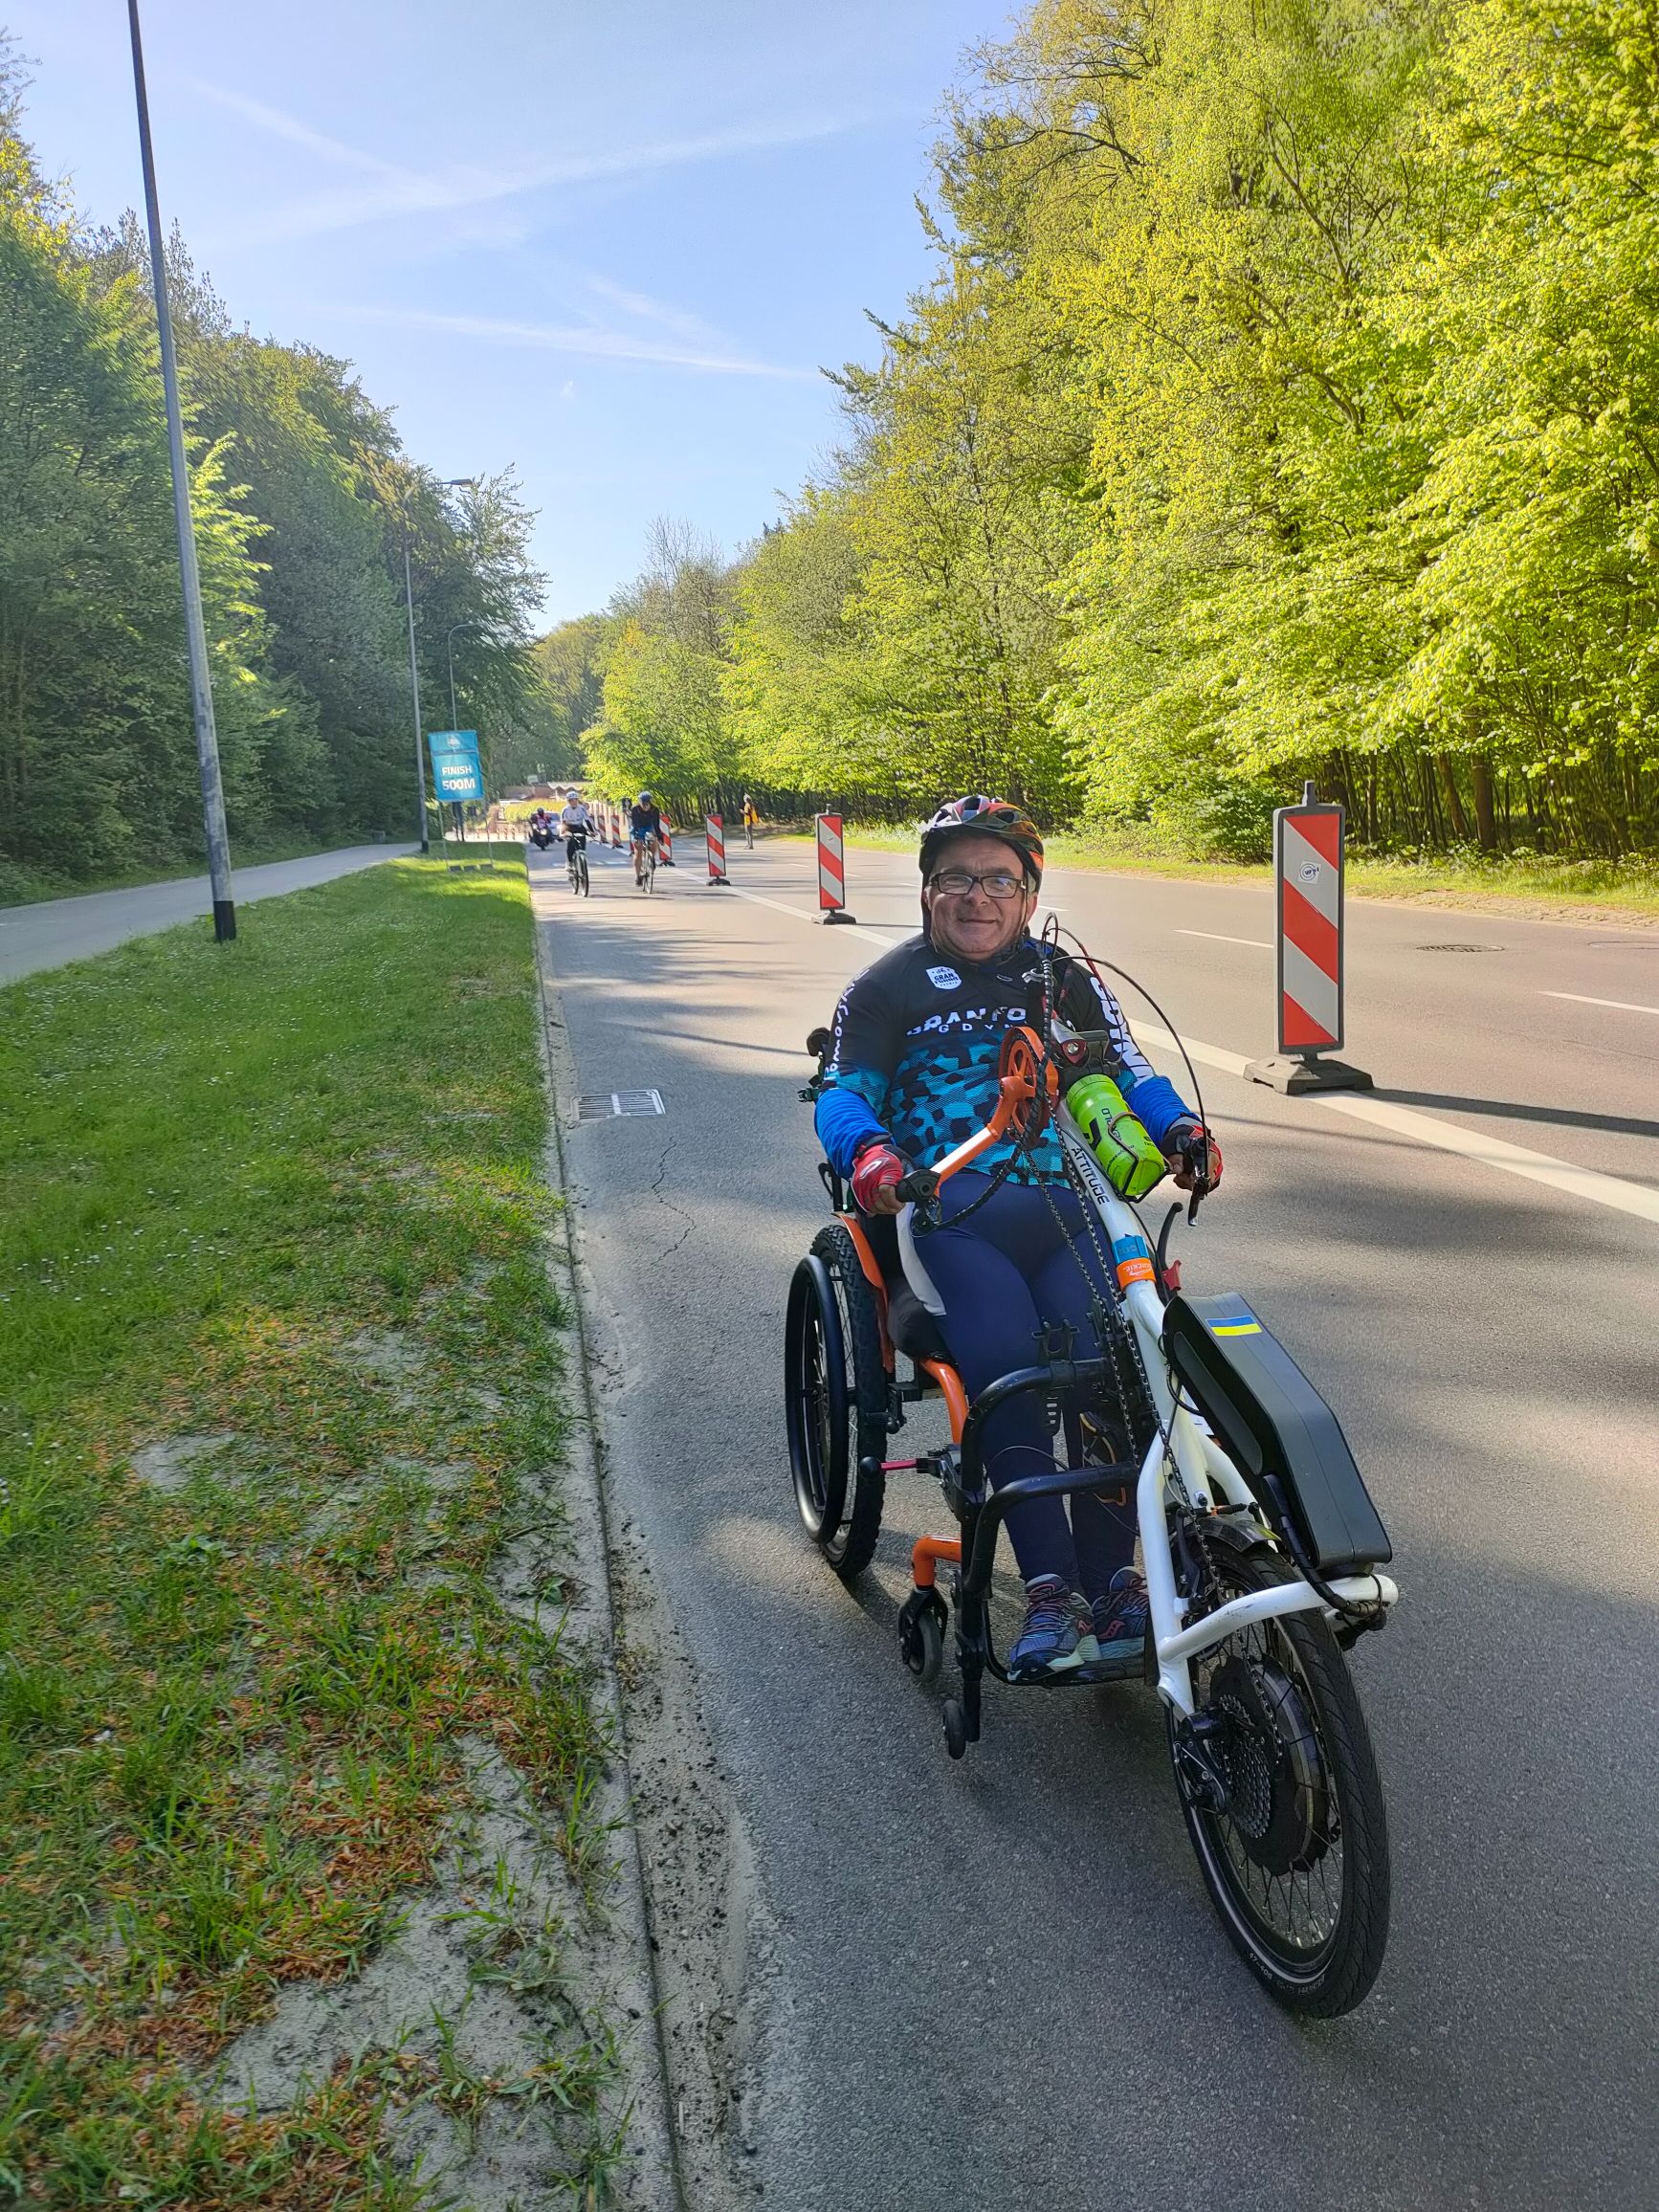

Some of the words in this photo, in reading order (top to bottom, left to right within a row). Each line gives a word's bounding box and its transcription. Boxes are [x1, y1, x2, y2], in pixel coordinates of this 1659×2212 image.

[441, 765, 473, 776] FINISH
[442, 778, 476, 790] 500M
[1071, 1147, 1111, 1206] ATTITUDE
